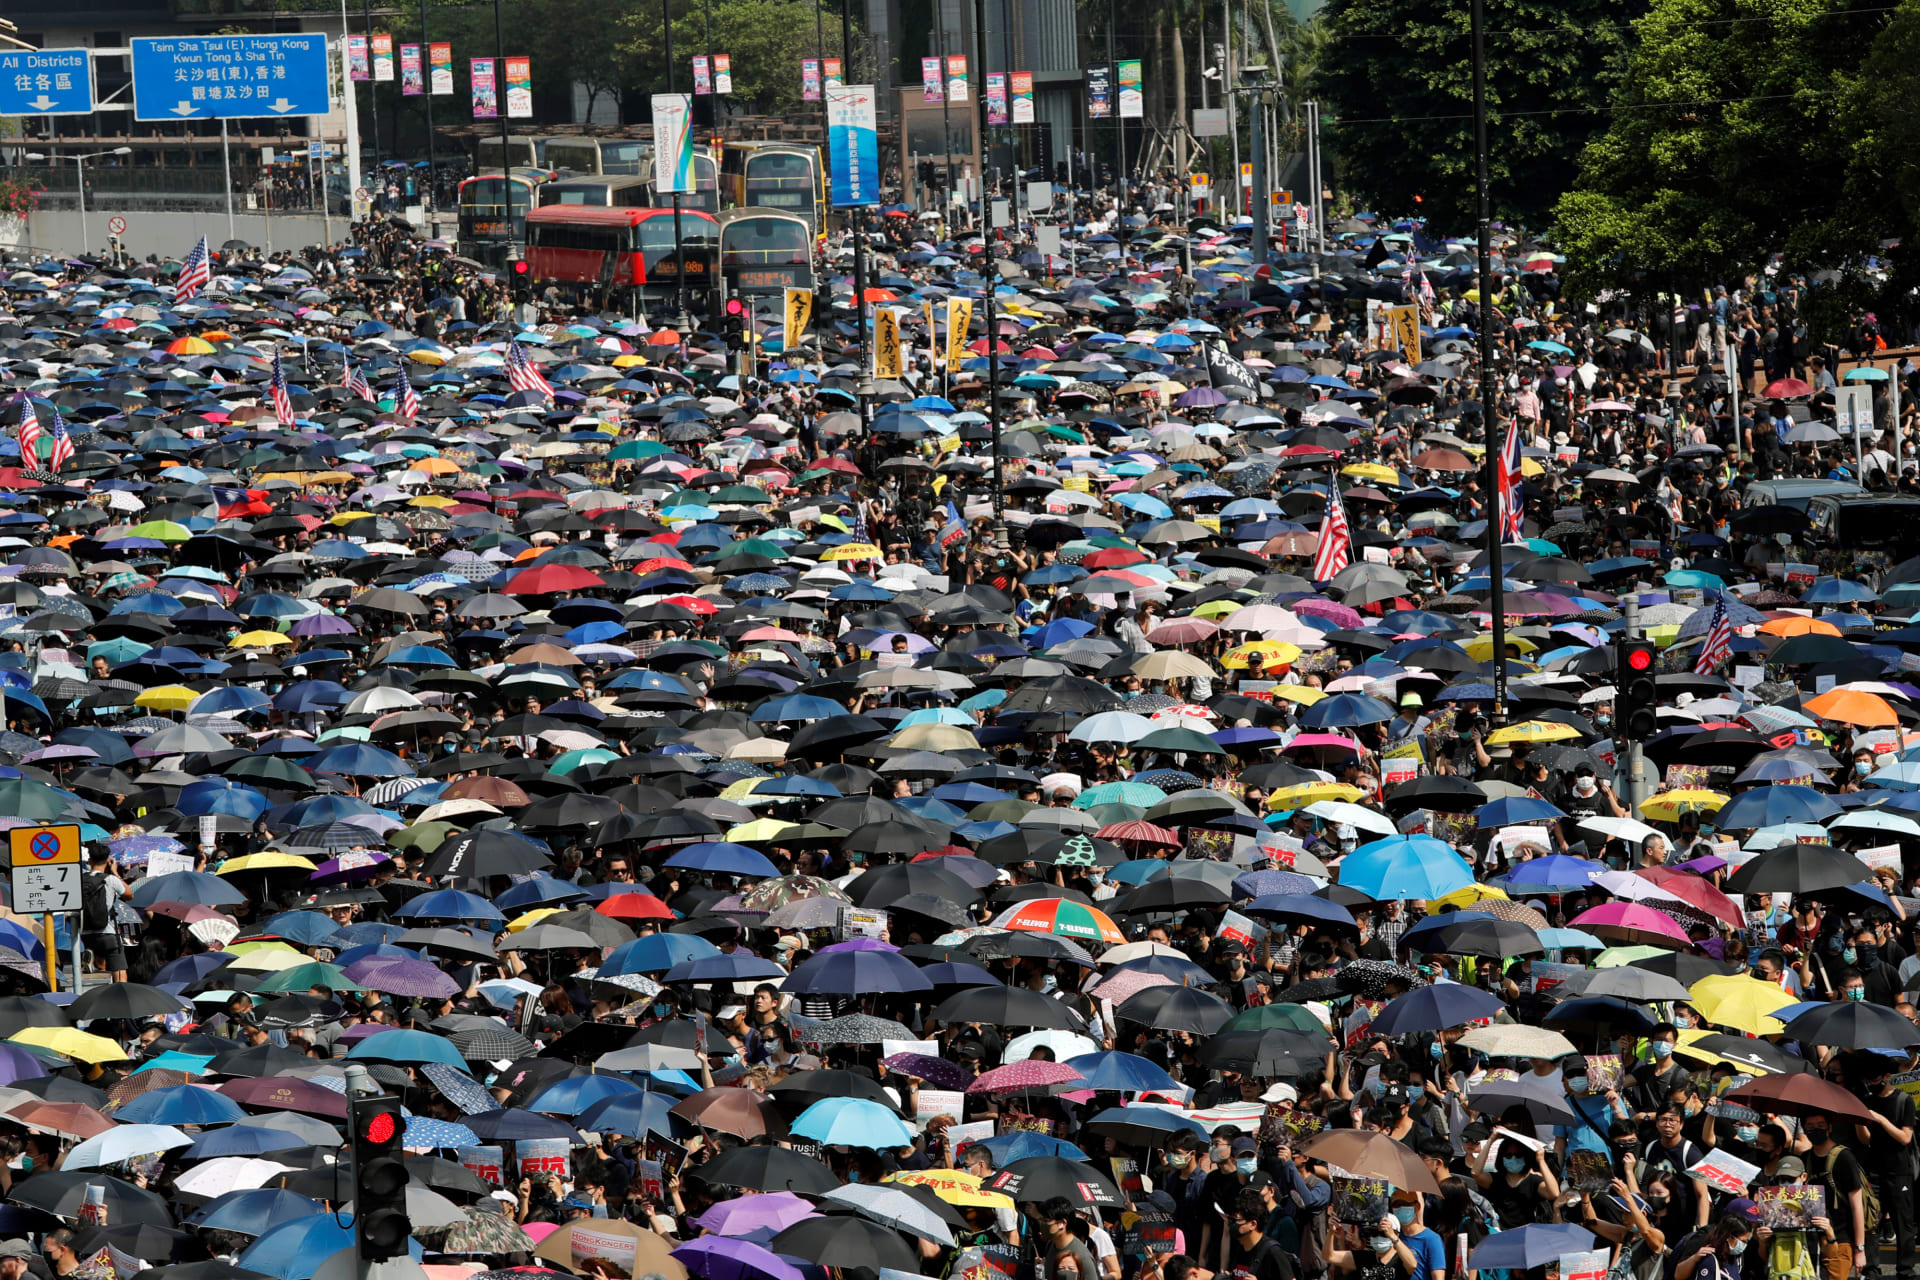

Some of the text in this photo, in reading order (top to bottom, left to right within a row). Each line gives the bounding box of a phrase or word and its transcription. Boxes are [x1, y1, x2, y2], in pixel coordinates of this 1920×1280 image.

[150, 41, 174, 53] Tsim
[178, 41, 198, 52] Sha
[201, 40, 223, 51] Tsui
[251, 39, 278, 51] Hong
[282, 39, 309, 51] Kong
[2, 54, 82, 68] All Districts
[174, 51, 285, 64] Kwun Tong & Sha Tin
[14, 72, 73, 92] 往各區
[192, 85, 270, 100] 觀塘及沙田
[1437, 813, 1478, 826] 正義必勝
[1191, 830, 1233, 844] 正義必勝
[448, 839, 472, 872] NOKIA
[25, 875, 46, 885] 上午
[57, 867, 68, 882] 7
[26, 899, 47, 909] 下午
[58, 891, 69, 907] 7
[1016, 918, 1050, 928] 7-ELEVEN
[1059, 923, 1096, 935] 7-ELEVEN
[1002, 1117, 1051, 1133] 正義必勝
[1268, 1106, 1322, 1131] 正義必勝
[521, 1156, 566, 1174] 反抗
[1336, 1181, 1387, 1196] 正義必勝
[1763, 1187, 1823, 1202] 正義必勝
[572, 1241, 597, 1255] RESIST
